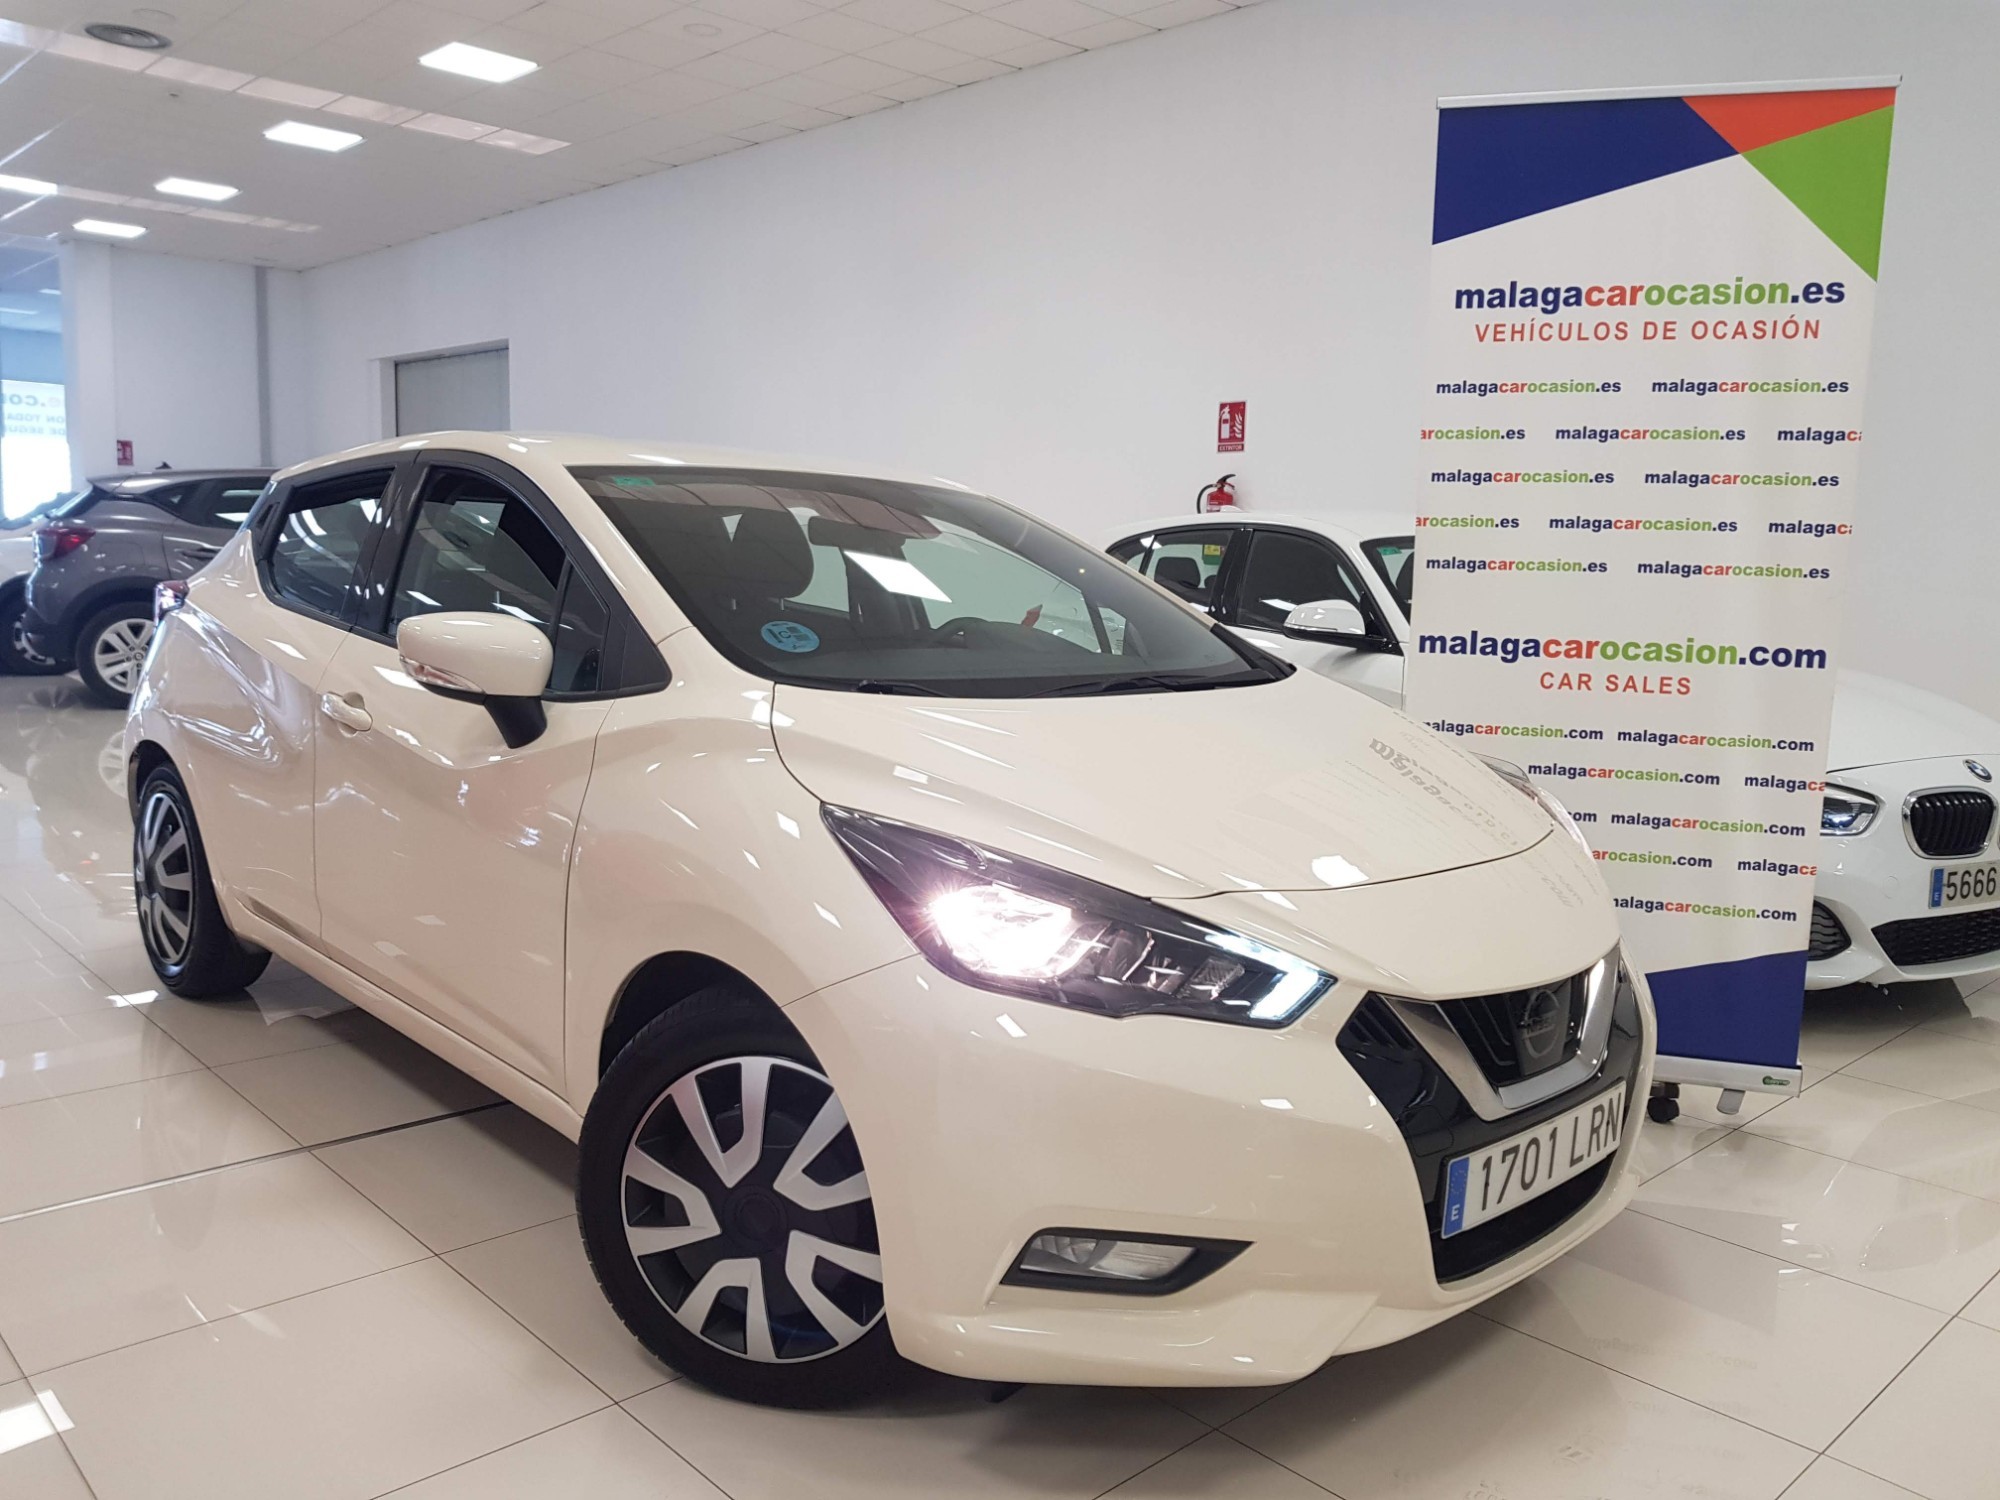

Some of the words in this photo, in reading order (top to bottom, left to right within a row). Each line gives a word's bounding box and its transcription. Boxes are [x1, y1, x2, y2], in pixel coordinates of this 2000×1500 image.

[1454, 277, 1846, 316] malagacarocasion.es
[1474, 318, 1629, 343] VEHÍCULOS
[1642, 321, 1678, 341] DE
[1690, 314, 1821, 341] OCASIÓN
[1436, 379, 1622, 397] malagacarocasion.es
[1651, 378, 1850, 396] malagacarocasion.es
[1555, 426, 1746, 444] malagacarocasion.es
[1431, 469, 1615, 486] malagacarocasion.es
[1645, 470, 1840, 488] malagacarocasion.es
[1549, 516, 1738, 533] malagacarocasion.es
[1426, 556, 1608, 573] malagacarocasion.es
[1637, 561, 1831, 580] malagacarocasion.es
[1418, 630, 1827, 670] malagacarocasion.com
[1539, 672, 1593, 692] CAR
[1605, 674, 1692, 695] SALES
[1424, 720, 1604, 741] alagacarocasion.com
[1617, 729, 1815, 752] malagacarocasion.com
[1528, 763, 1721, 786] malagacarocasion.com
[1611, 813, 1806, 837] malagacarocasion.com
[1946, 866, 1998, 901] 5666
[1450, 1203, 1461, 1221] E
[1481, 1126, 1558, 1212] 1701
[1569, 1092, 1622, 1168] LRN
